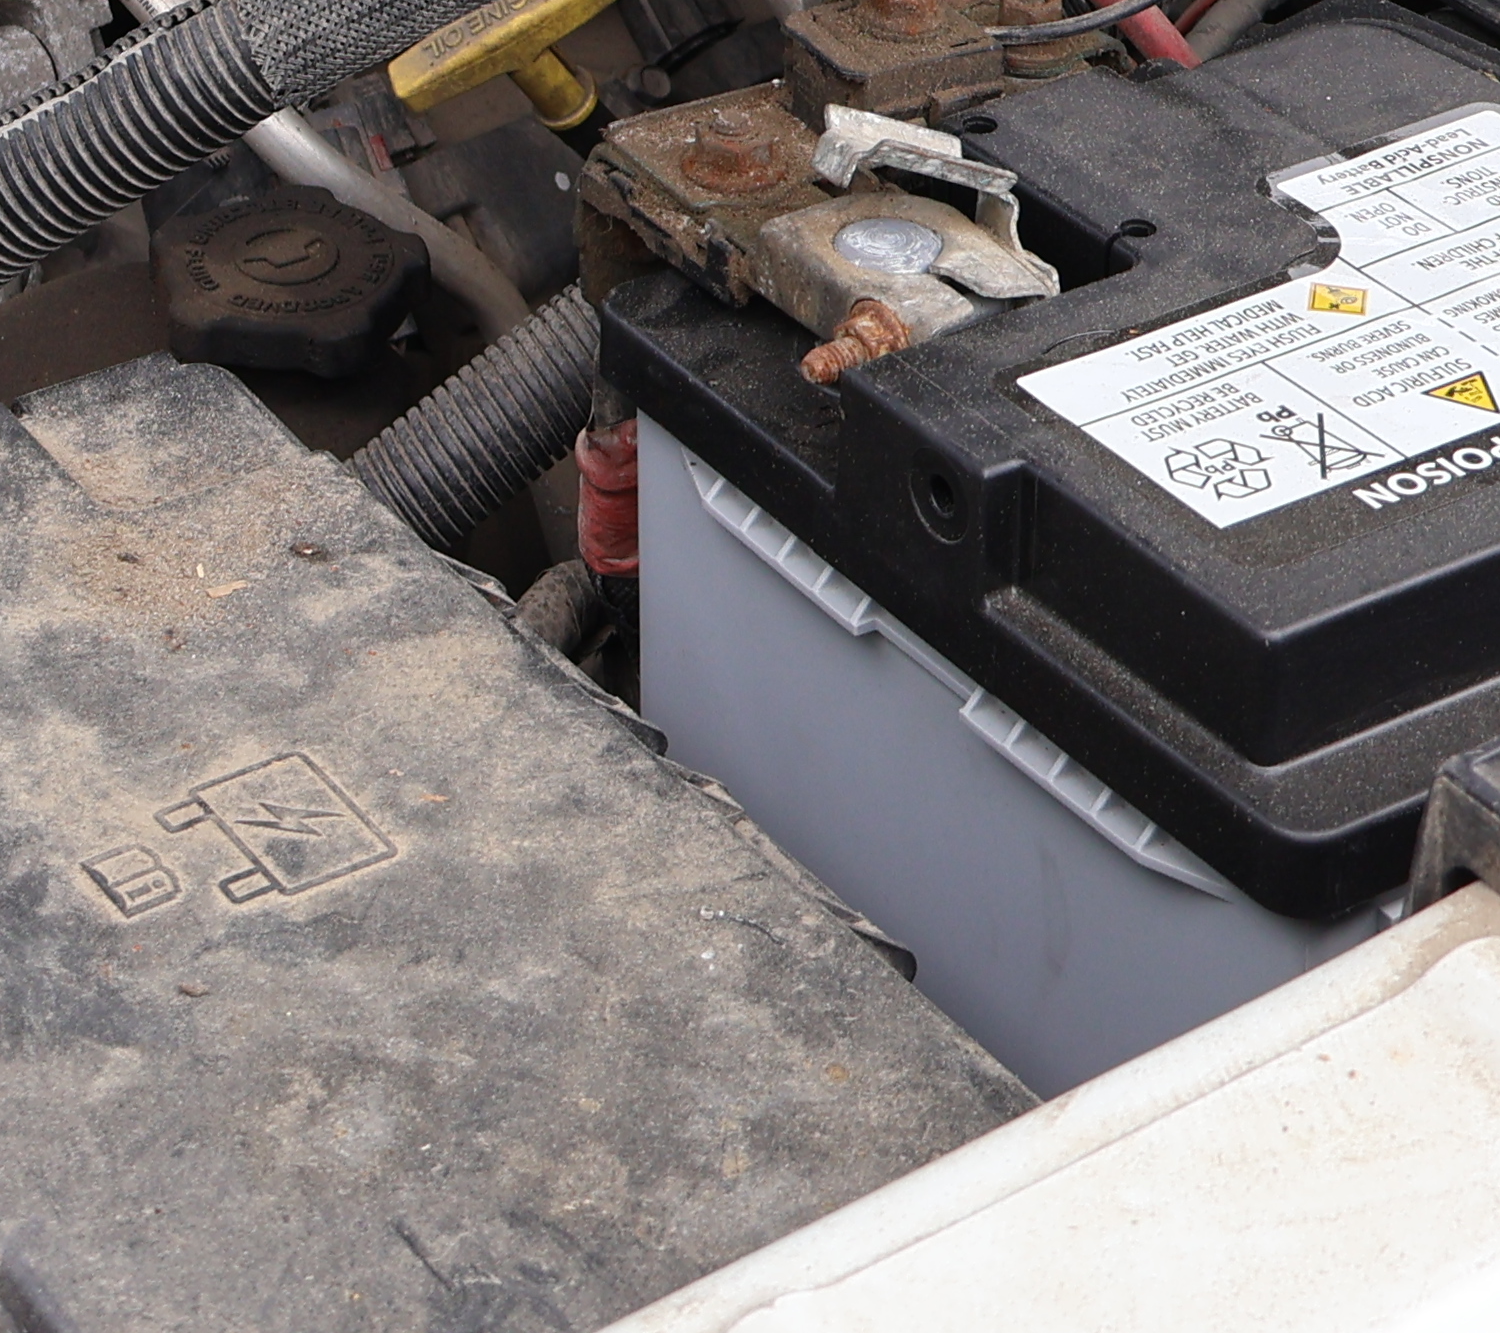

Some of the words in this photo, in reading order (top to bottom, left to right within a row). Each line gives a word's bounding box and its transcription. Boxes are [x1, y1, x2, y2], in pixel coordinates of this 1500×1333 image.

[419, 25, 468, 63] OIL
[1380, 127, 1474, 165] Lead-Acid
[1313, 157, 1386, 187] Battery
[1338, 137, 1490, 196] NONSPILLABLE
[1439, 165, 1497, 190] TIONS.
[1342, 200, 1397, 224] OPEN.
[1375, 211, 1414, 229] NOT
[1400, 221, 1431, 237] DO
[1409, 236, 1498, 272] CHILDREN.
[1459, 252, 1499, 271] THE
[1206, 299, 1285, 332] MEDICAL
[1252, 311, 1303, 333] WITH
[1165, 324, 1215, 347] HELP
[1193, 326, 1260, 355] WATER.
[1264, 322, 1322, 348] FLUSH
[1355, 319, 1413, 345] SEVERE
[1123, 340, 1172, 362] FAST.
[1162, 349, 1201, 367] GET
[1225, 341, 1271, 362] EYES
[1304, 338, 1362, 363] BURNS.
[1350, 332, 1432, 366] BLINDNESS
[1414, 344, 1452, 362] CAN
[1116, 355, 1232, 402] IMMEDIATELY
[1328, 359, 1358, 374] OR
[1370, 356, 1422, 379] CAUSE
[1387, 357, 1473, 394] SULFURIC
[1207, 382, 1239, 398] BE
[1349, 386, 1396, 408] ACID
[1127, 390, 1215, 427] RECYCLED
[1184, 391, 1263, 424] BATTERY
[1252, 404, 1298, 425] Pb
[1138, 417, 1193, 442] MUST
[1201, 459, 1236, 476] Pb
